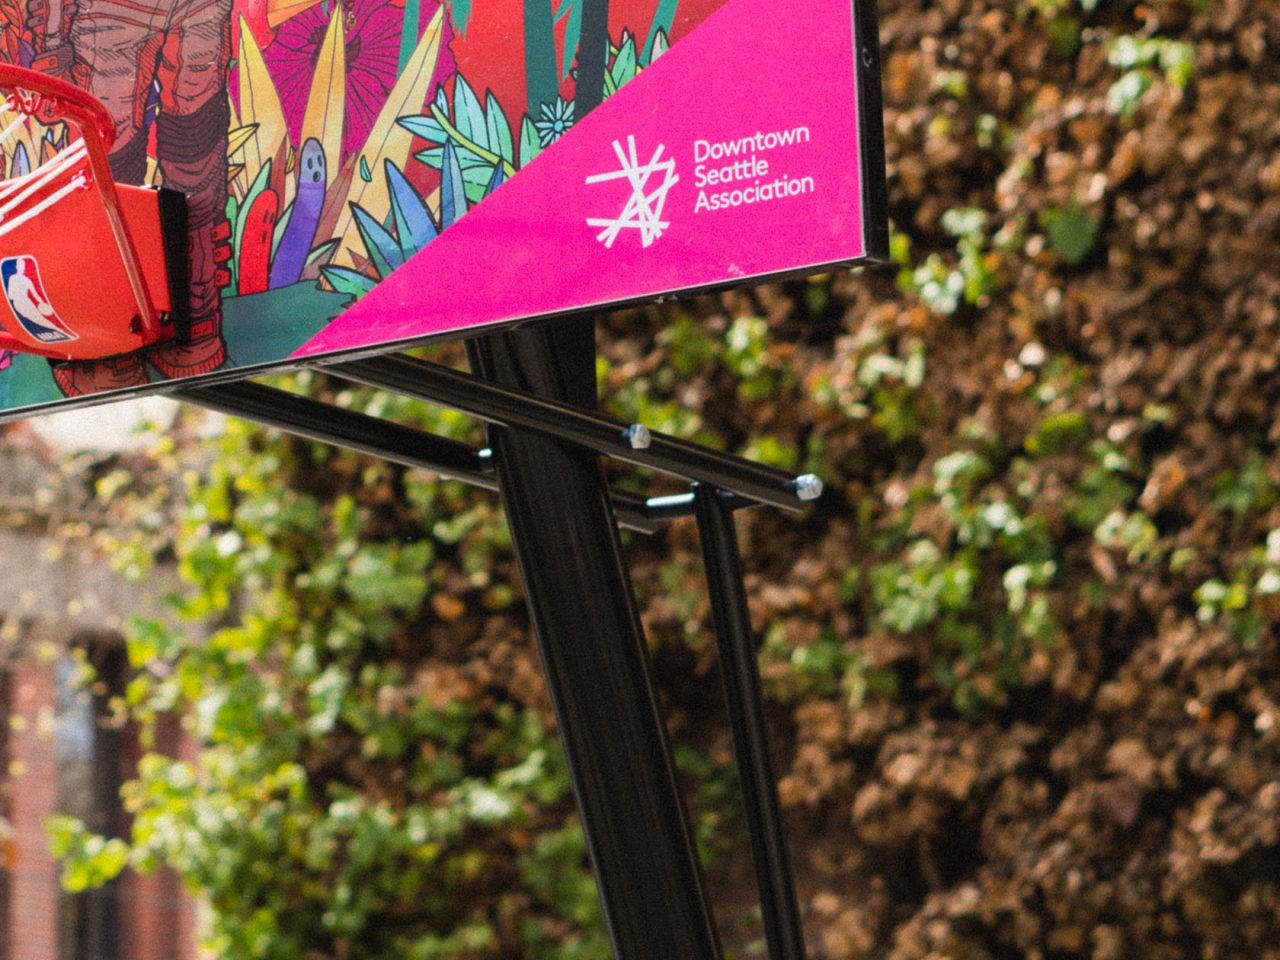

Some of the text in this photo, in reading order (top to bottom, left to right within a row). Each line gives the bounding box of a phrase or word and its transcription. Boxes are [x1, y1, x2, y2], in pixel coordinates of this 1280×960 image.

[694, 126, 810, 163] Downtown
[694, 155, 769, 188] Seattle
[693, 176, 815, 214] Association
